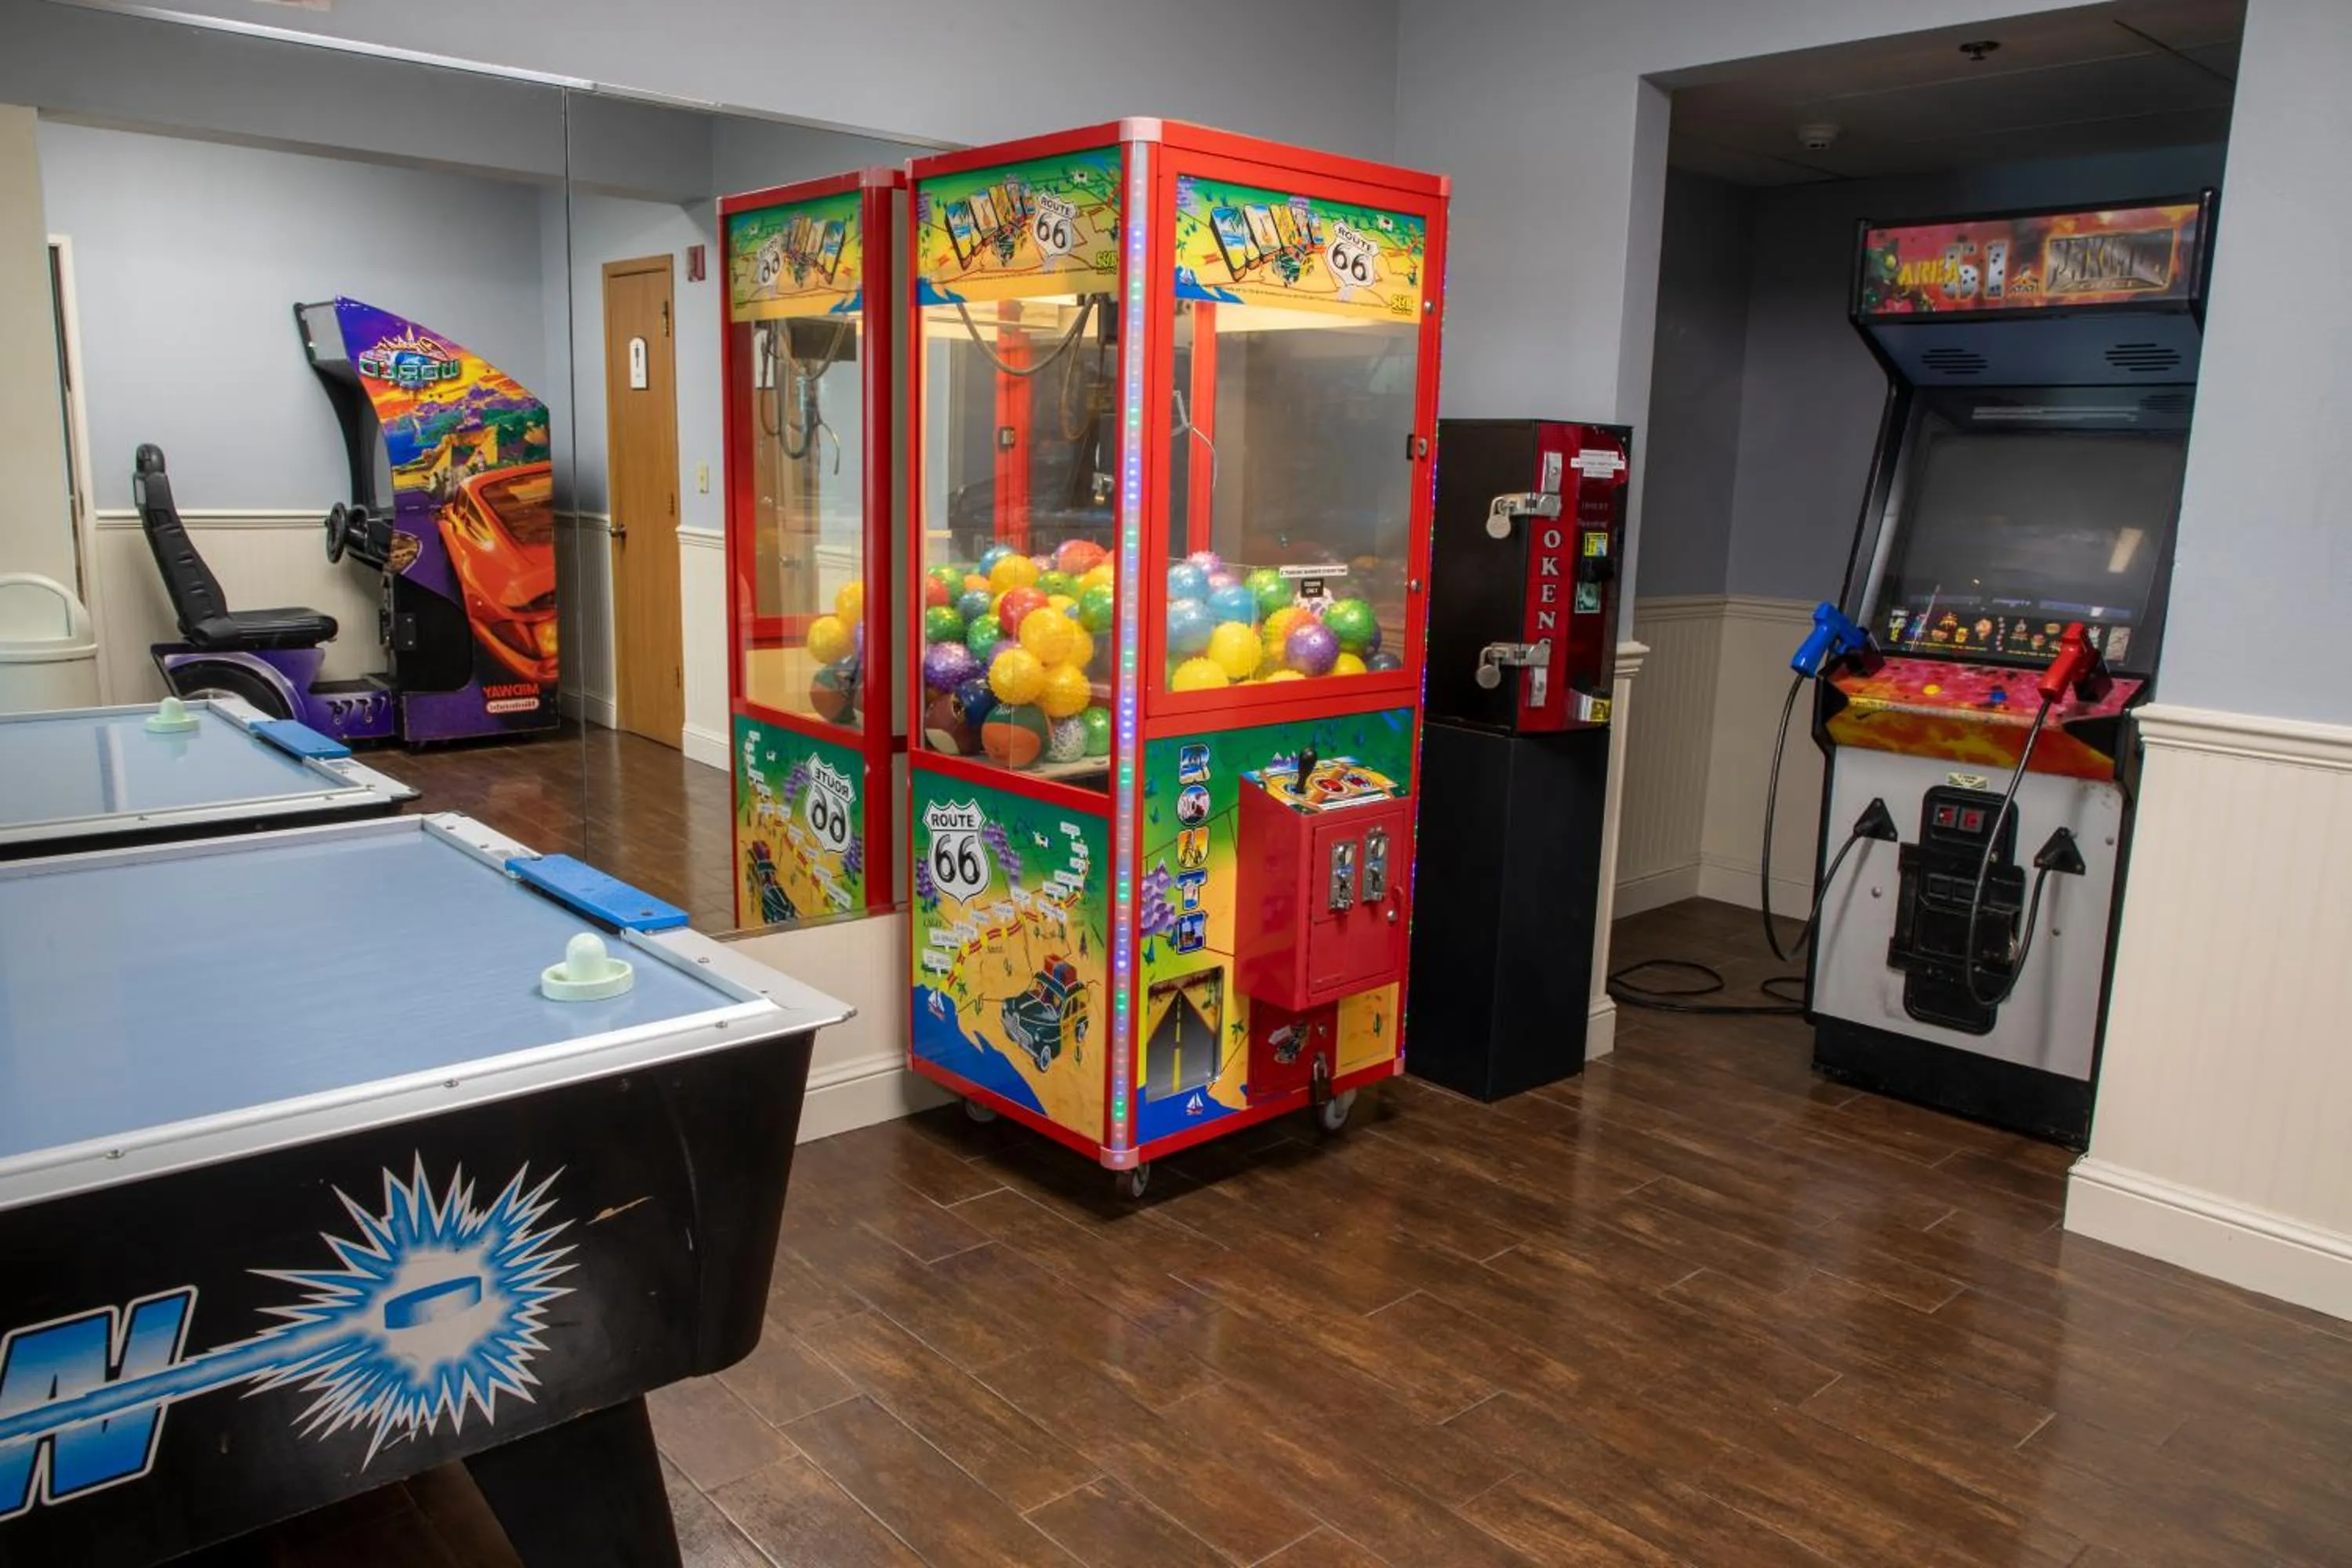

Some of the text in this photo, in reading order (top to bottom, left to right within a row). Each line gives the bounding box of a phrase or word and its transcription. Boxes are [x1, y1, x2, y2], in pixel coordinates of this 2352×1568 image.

[1040, 197, 1071, 216] ROUTE
[1036, 212, 1066, 249] 66
[1338, 226, 1373, 252] ROUTE
[1332, 241, 1367, 282] 66
[1537, 517, 1563, 648] OKEN
[931, 813, 975, 828] ROUTE
[934, 833, 981, 885] 66
